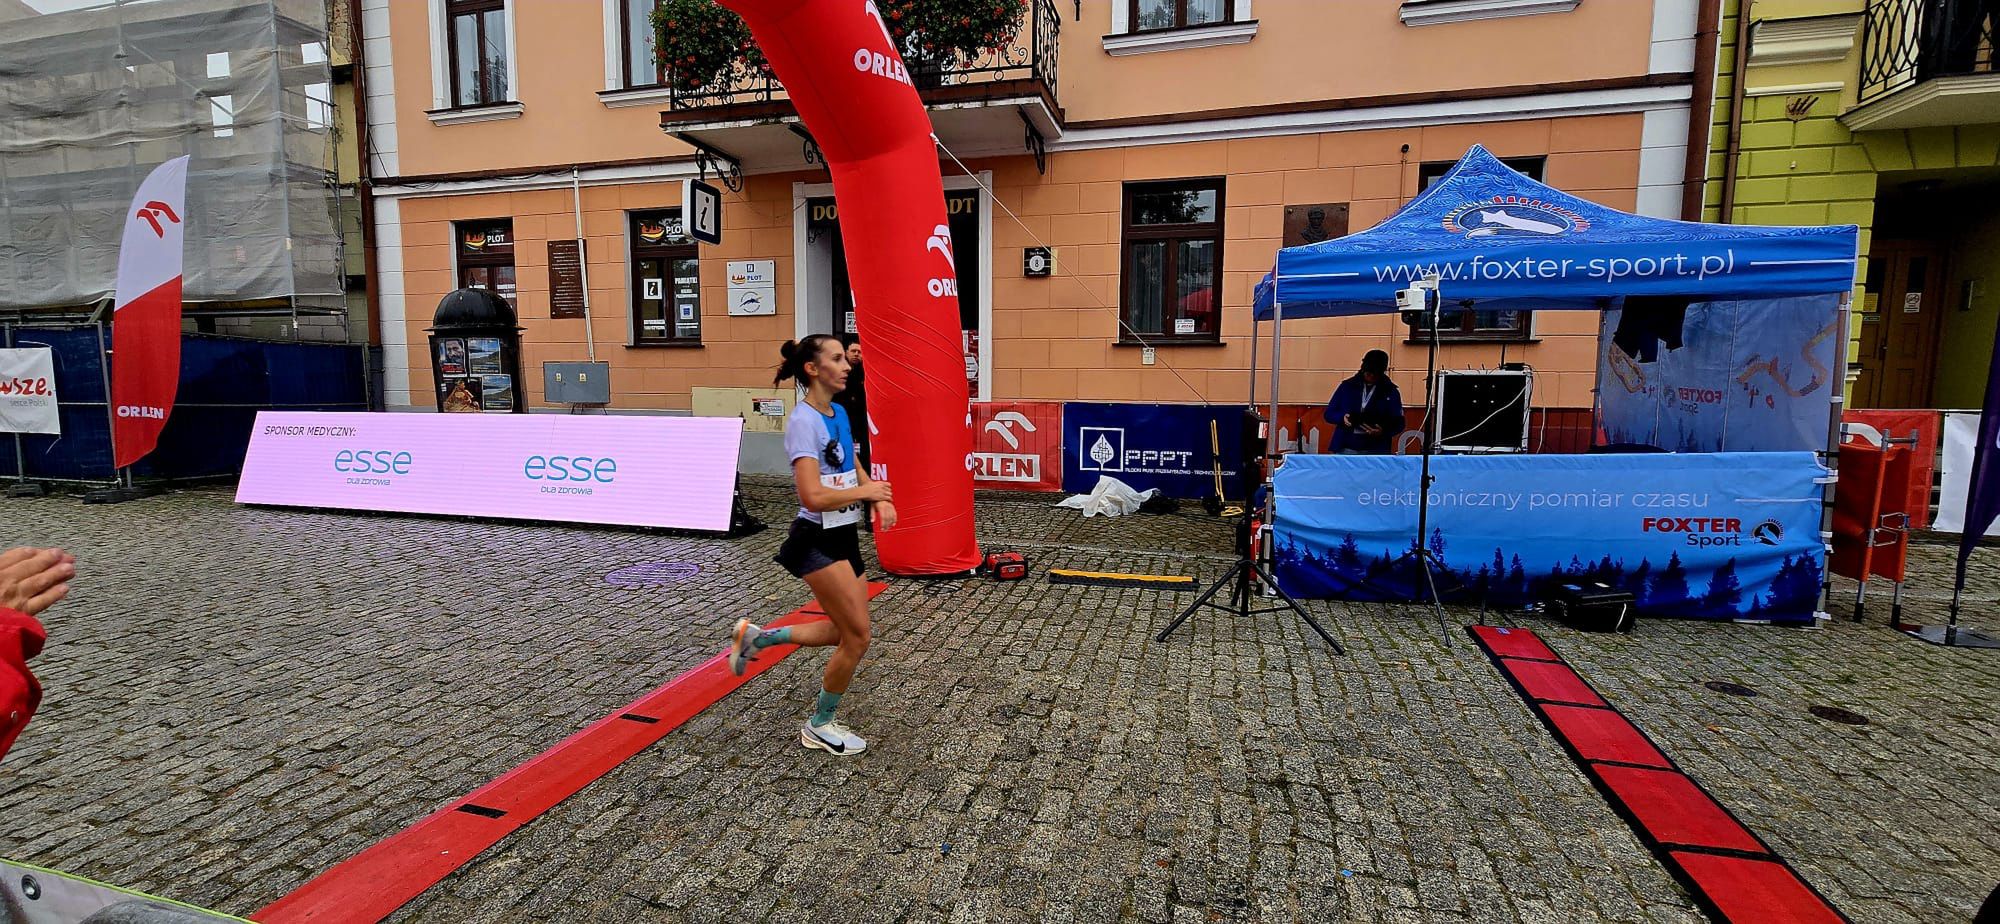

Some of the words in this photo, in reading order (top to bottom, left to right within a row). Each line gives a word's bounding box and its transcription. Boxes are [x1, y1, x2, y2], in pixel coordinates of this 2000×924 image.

[487, 234, 505, 243] PLOT
[1373, 248, 1734, 283] www.foxter-sport.pl
[117, 405, 164, 419] ORLEN
[264, 425, 305, 436] SPONSOR
[306, 426, 357, 437] MEDYCZNY:
[334, 449, 412, 475] esse
[1125, 450, 1192, 467] PPPT
[524, 455, 617, 483] esse
[1529, 488, 1625, 511] pomiar
[1632, 492, 1708, 508] czasu
[1643, 517, 1741, 533] FOXTER
[1686, 533, 1741, 549] Sport
